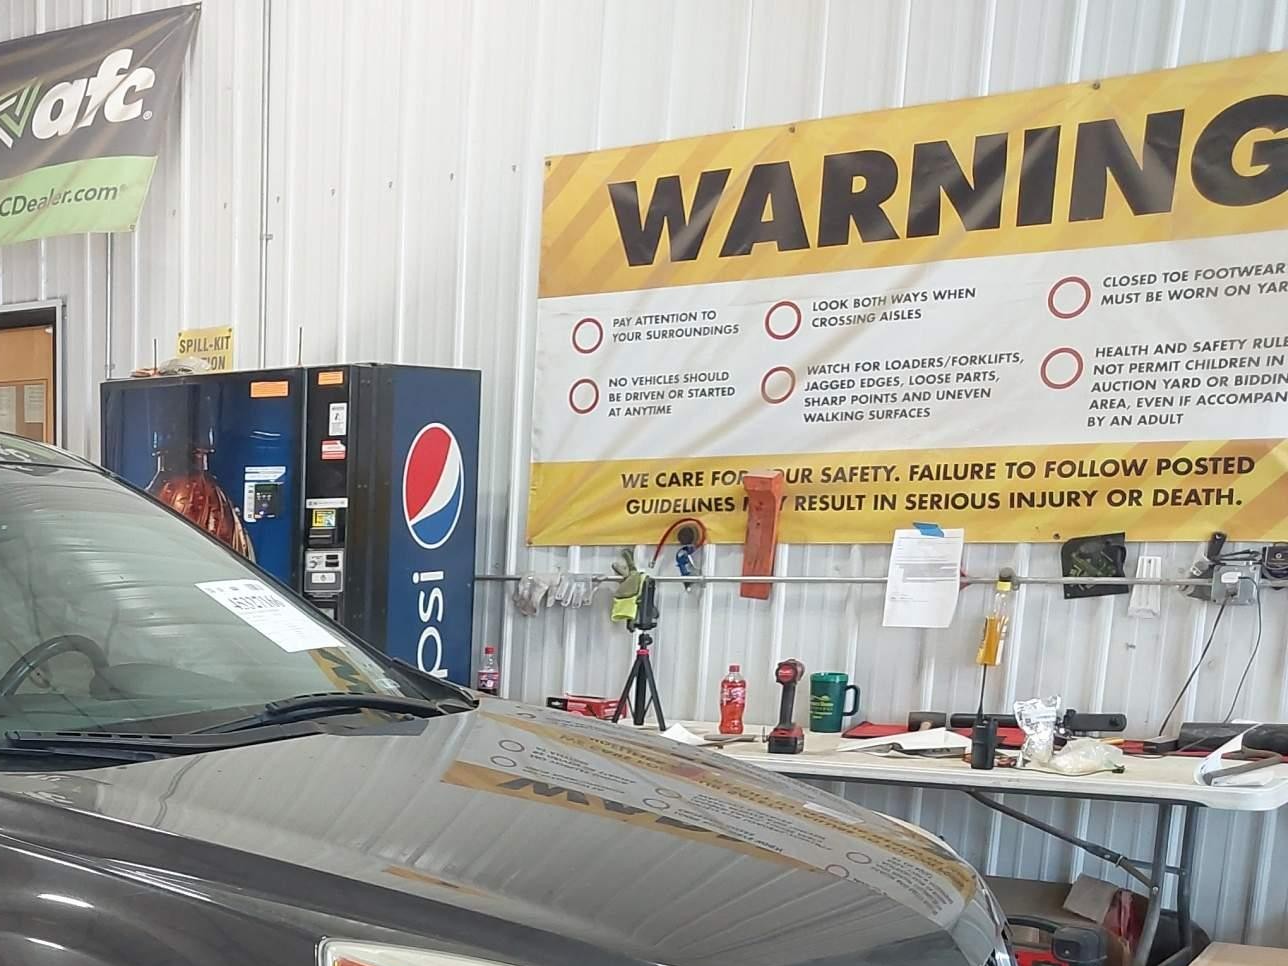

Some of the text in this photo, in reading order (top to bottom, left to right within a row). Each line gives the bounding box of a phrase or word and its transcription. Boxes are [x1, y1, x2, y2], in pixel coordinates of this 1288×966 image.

[607, 94, 1288, 267] WARNING
[1103, 262, 1286, 288] CLOSED TOE FOOTWEAR
[812, 287, 976, 312] LOOK BOTH WAYS WHEN
[1100, 292, 1141, 306] MUST
[1145, 290, 1163, 302] BE
[1168, 286, 1219, 301] WORN
[1224, 284, 1251, 297] ON
[612, 310, 717, 328] PAY ATTENTION TO
[811, 308, 922, 328] CROSSING AISLES
[612, 324, 739, 342] YOUR SURROUNDINGS
[179, 335, 231, 354] SPILL-KIT
[1095, 344, 1149, 358] HEALTH
[1154, 342, 1187, 355] AND
[1192, 338, 1247, 353] SAFETY
[807, 352, 1025, 375] WATCH FOR LOADERS/FORKLIFTS,
[1093, 354, 1285, 375] NOT PERMIT CHILDREN IN
[609, 371, 730, 387] NO VEHICLES SHOULD
[804, 370, 1000, 392] JAGGED EDGES, LOOSE PARTS,
[1091, 379, 1157, 393] AUCTION
[1162, 377, 1201, 390] YARD
[1206, 375, 1229, 388] OR
[609, 386, 736, 402] BE DRIVEN OR STARTED
[804, 388, 991, 407] SHARP POINTS AND UNEVEN
[1089, 398, 1131, 411] AREA,
[1136, 396, 1174, 408] EVEN
[1179, 395, 1191, 406] IF
[608, 405, 672, 417] AT ANYTIME
[803, 407, 931, 423] WALKING SURFACES
[1087, 413, 1184, 427] BY AN ADULT
[621, 473, 649, 489] WE
[655, 471, 704, 488] CARE
[820, 465, 900, 483] SAFETY.
[908, 462, 996, 482] FAILURE
[1005, 460, 1036, 479] TO
[1044, 458, 1147, 479] FOLLOW
[1156, 456, 1255, 476] POSTED
[626, 496, 736, 515] GUIDELINES
[794, 494, 867, 512] RESULT
[872, 493, 897, 511] IN
[905, 492, 1001, 511] SERIOUS
[1009, 489, 1097, 509] INJURY
[1106, 489, 1143, 506] OR
[1152, 487, 1242, 507] DEATH.
